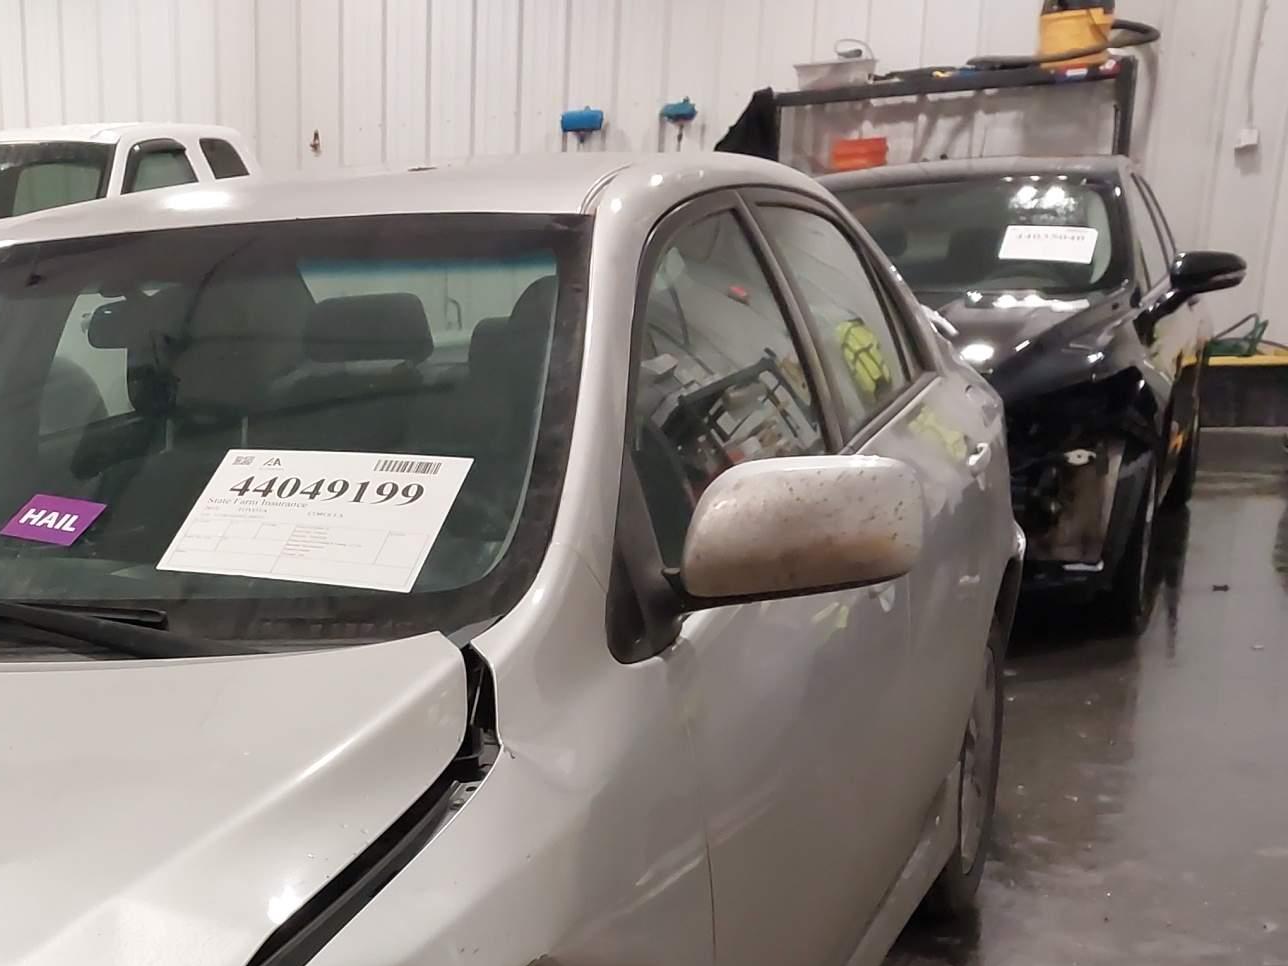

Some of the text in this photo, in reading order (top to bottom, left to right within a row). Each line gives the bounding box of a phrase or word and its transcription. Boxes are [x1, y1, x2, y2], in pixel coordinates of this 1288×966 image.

[229, 476, 424, 506] 44049199
[234, 498, 259, 506] Farm
[19, 508, 80, 532] HAIL
